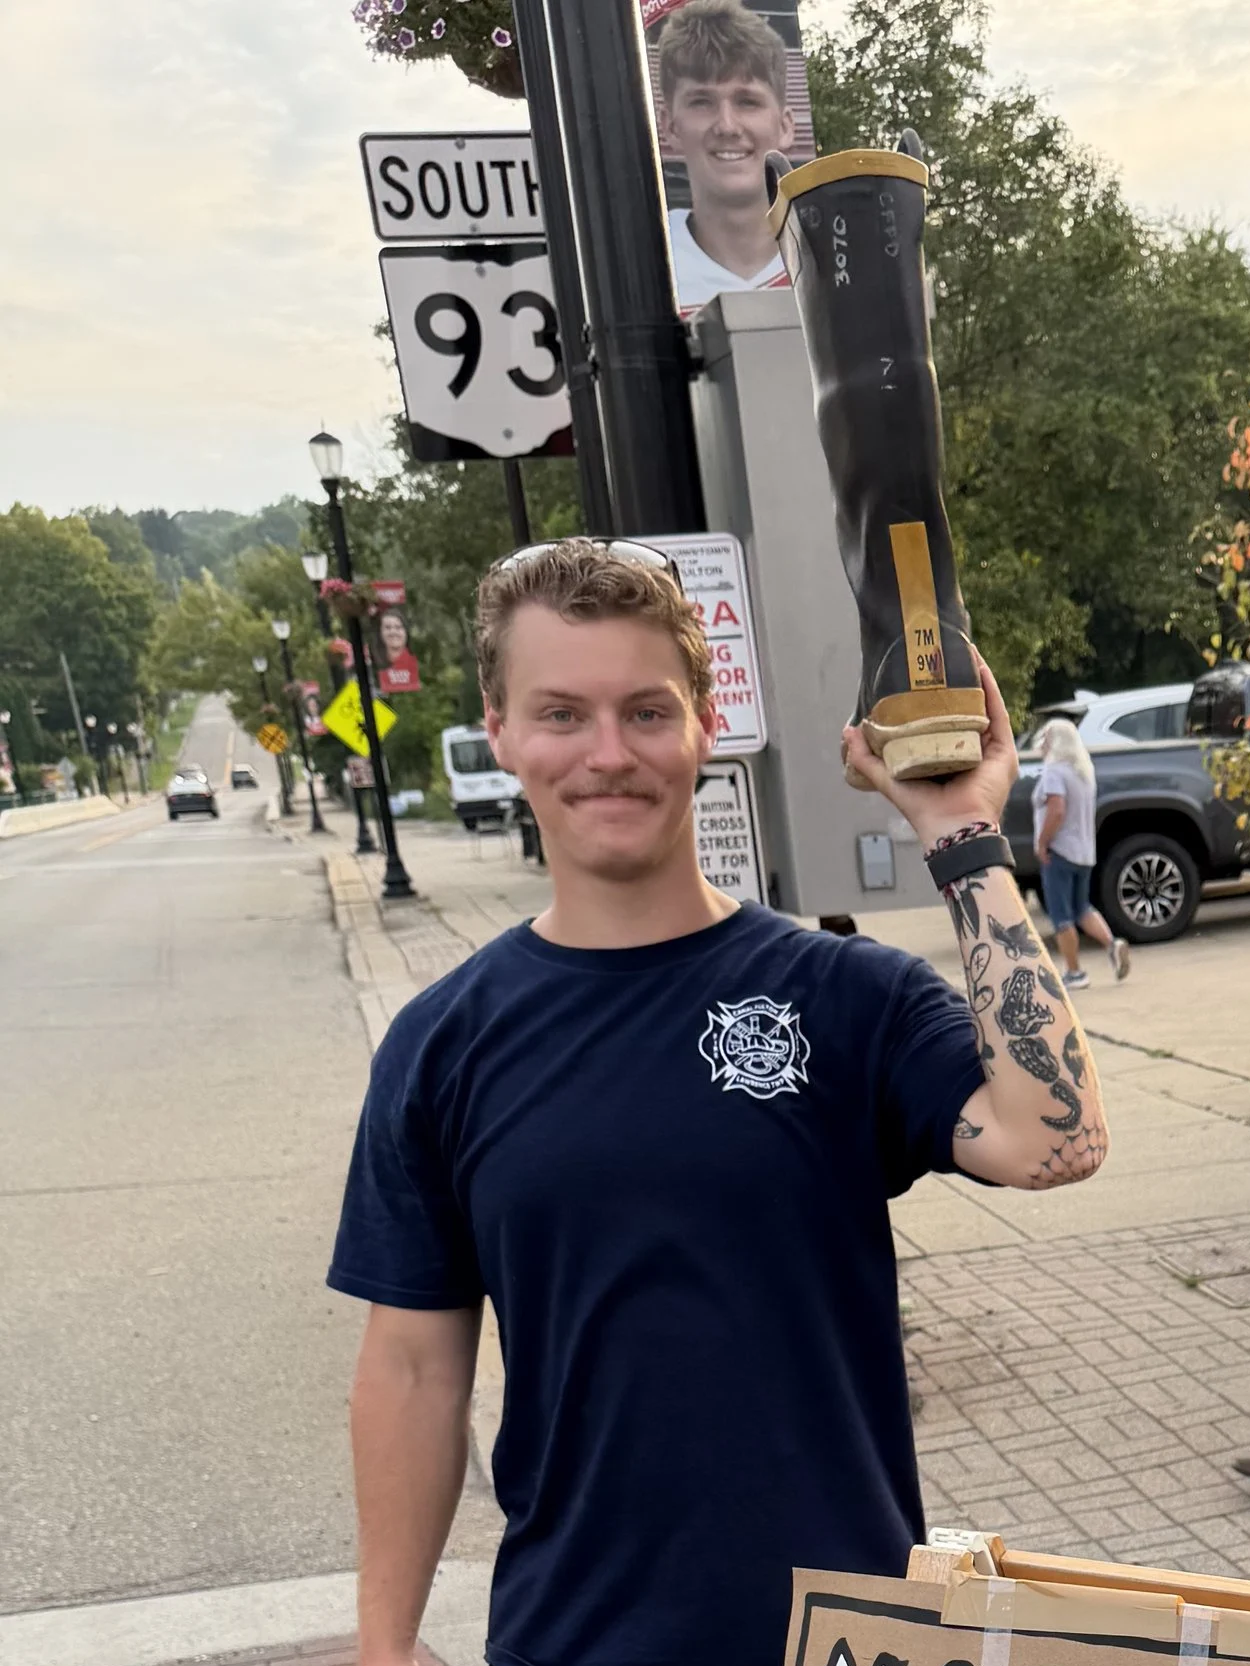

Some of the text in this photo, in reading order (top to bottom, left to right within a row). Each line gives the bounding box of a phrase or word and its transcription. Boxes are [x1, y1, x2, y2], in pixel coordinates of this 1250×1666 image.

[379, 156, 540, 220] SOUTH
[832, 215, 850, 287] 3070
[414, 290, 567, 399] 93
[915, 628, 935, 646] 7M
[917, 653, 938, 671] 9W
[700, 816, 746, 832] CROSS
[699, 835, 749, 851] STREET
[721, 854, 750, 869] FOR
